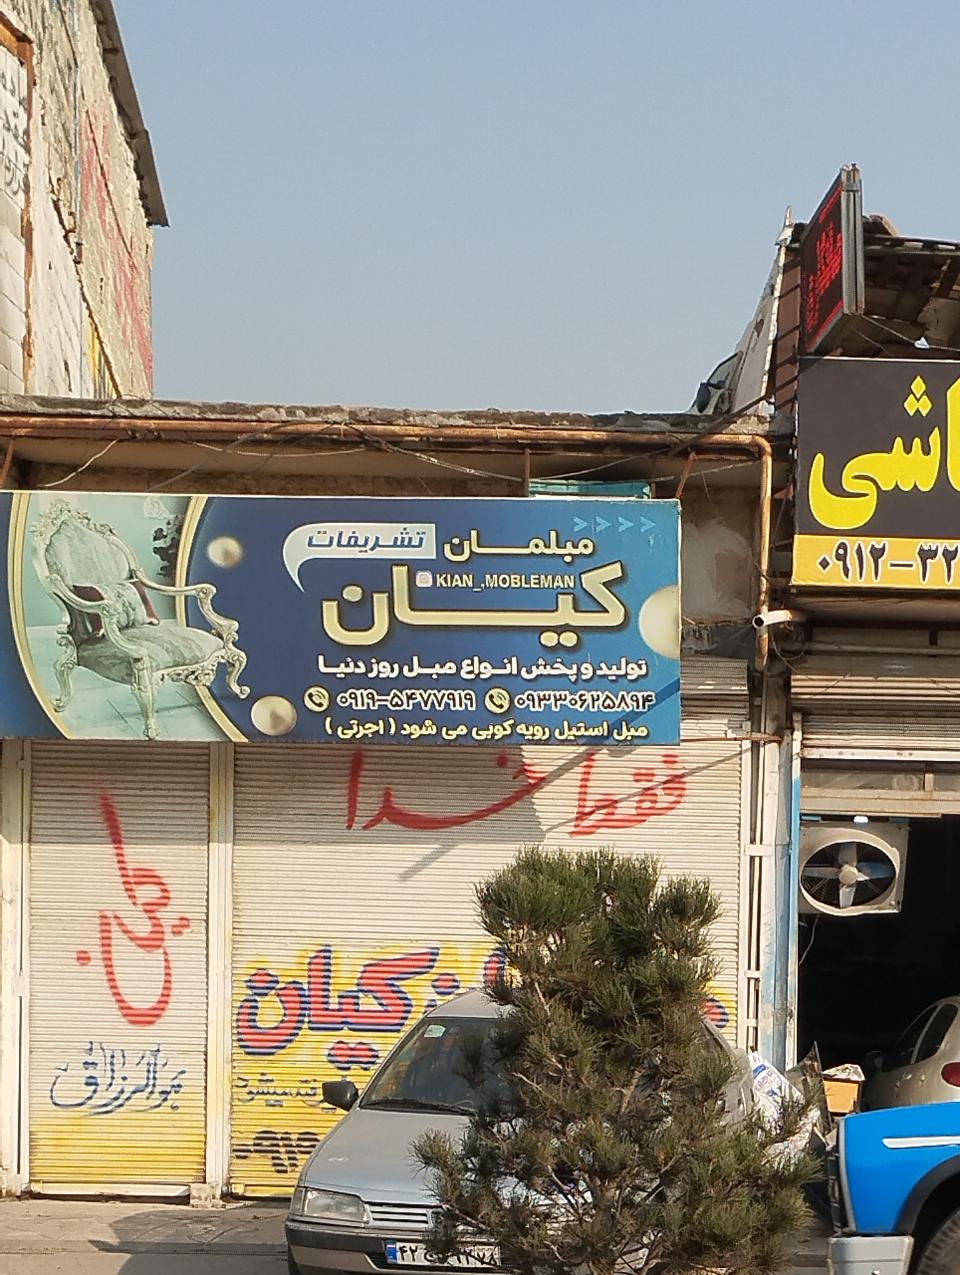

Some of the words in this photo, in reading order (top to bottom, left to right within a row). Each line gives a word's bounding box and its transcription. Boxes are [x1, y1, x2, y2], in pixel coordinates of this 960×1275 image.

[307, 528, 427, 553] تشریفات
[443, 529, 594, 563] مبلمان
[321, 560, 627, 647] کیان
[317, 653, 367, 679] دنیا
[367, 655, 401, 679] روز
[403, 655, 458, 679] مبل
[460, 655, 518, 680] انواع
[520, 655, 578, 682] پخش
[580, 660, 594, 680] و
[595, 656, 648, 680] تولید
[400, 718, 438, 740] شود
[441, 721, 469, 741] می
[471, 718, 516, 741] کوبی
[515, 721, 551, 741] رویه
[554, 719, 610, 741] استیل
[613, 720, 649, 741] مبل
[345, 748, 546, 831] خدا
[569, 752, 687, 838] فقط
[235, 943, 441, 1070] کیان
